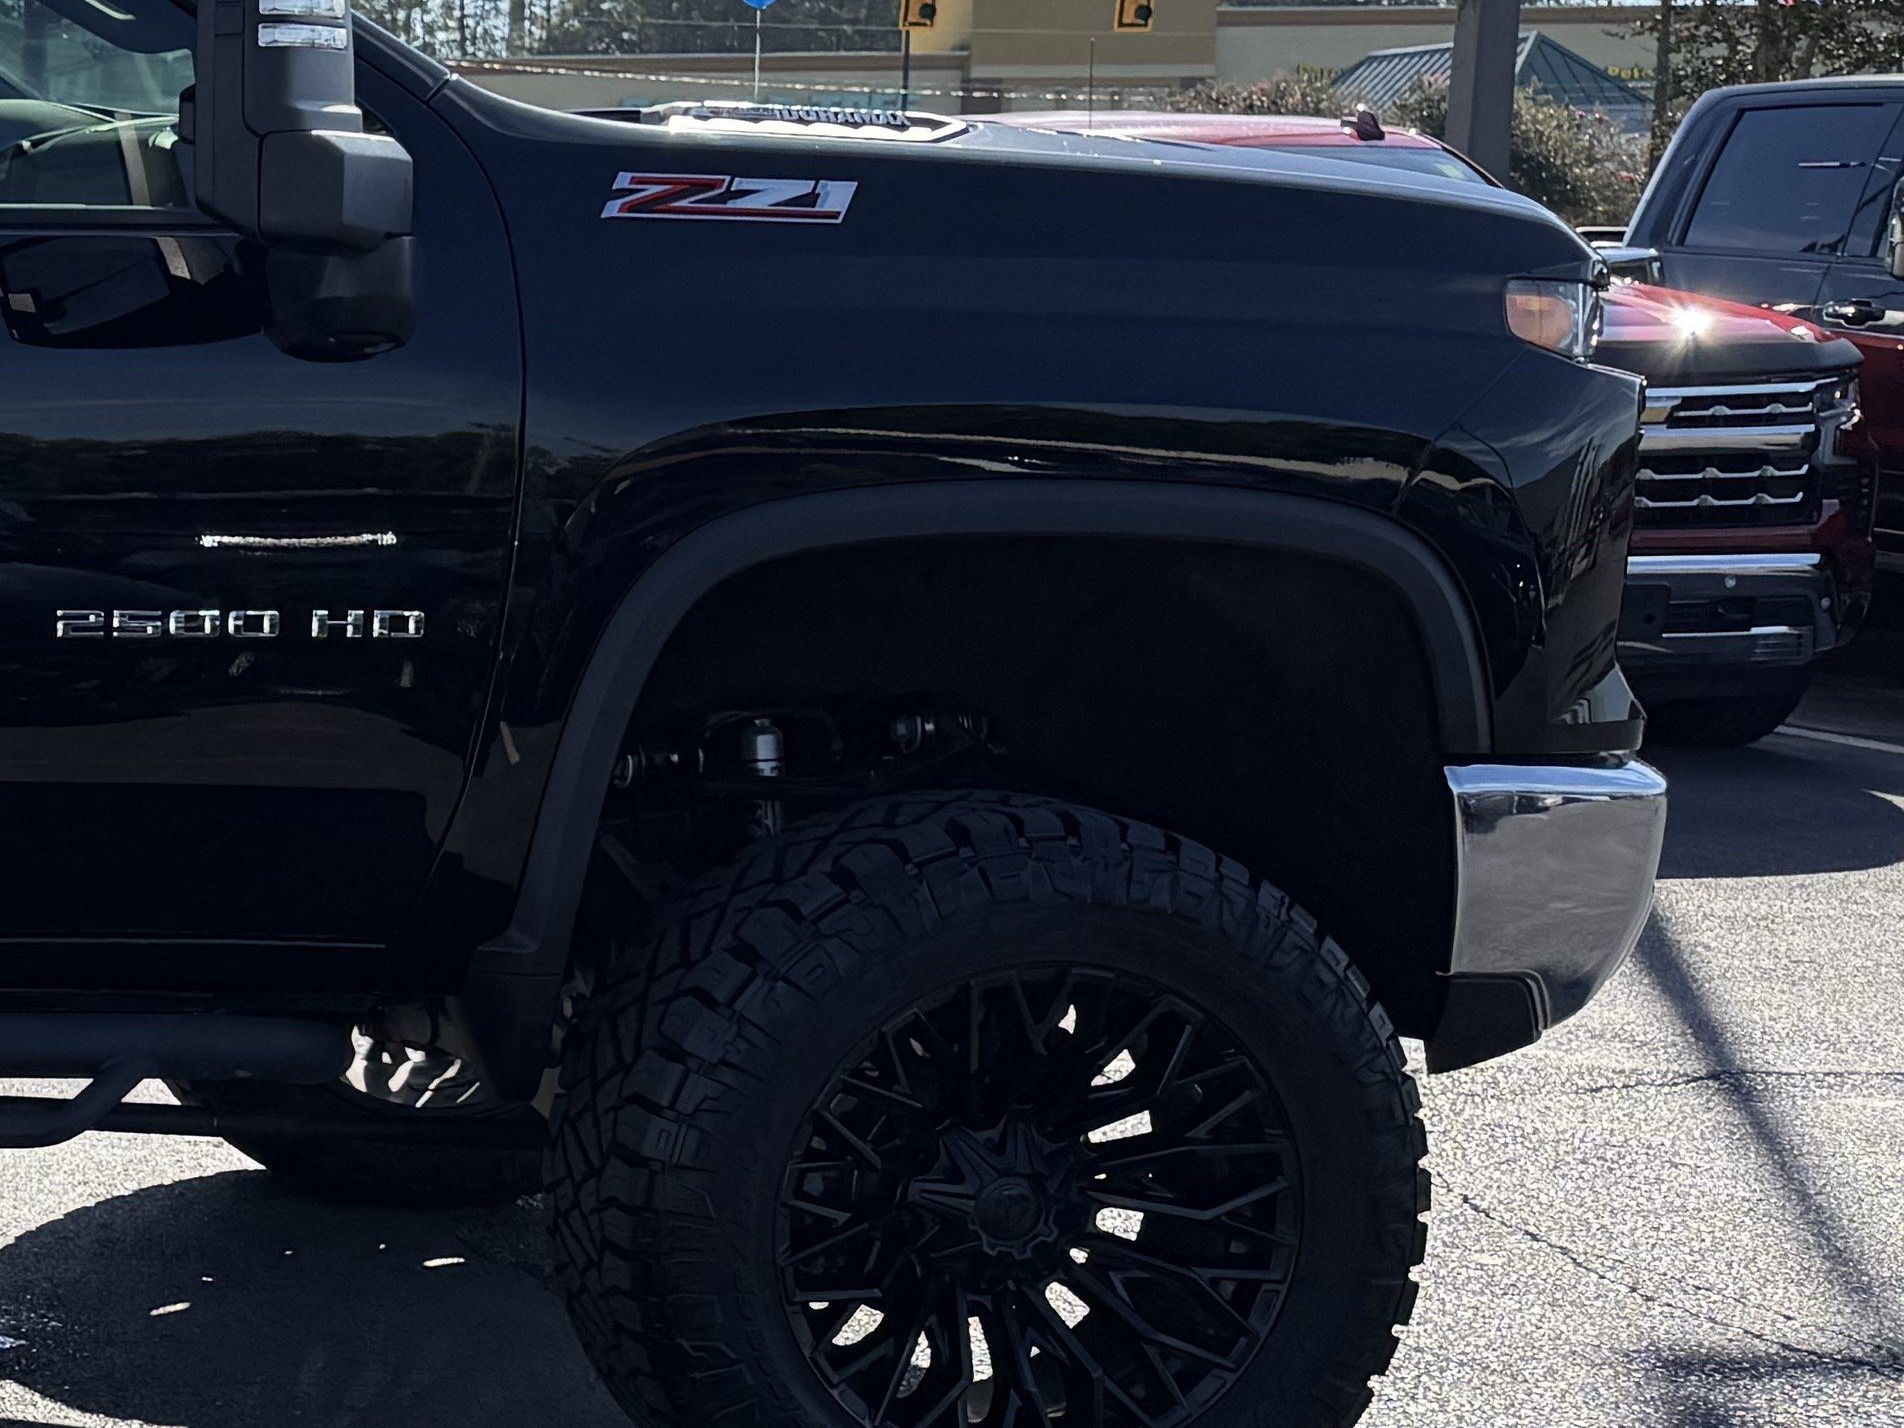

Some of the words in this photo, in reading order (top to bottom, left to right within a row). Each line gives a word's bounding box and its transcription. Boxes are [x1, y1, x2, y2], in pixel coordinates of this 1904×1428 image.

[600, 171, 859, 224] Z71
[56, 609, 280, 638] 2500
[311, 609, 425, 638] HD
